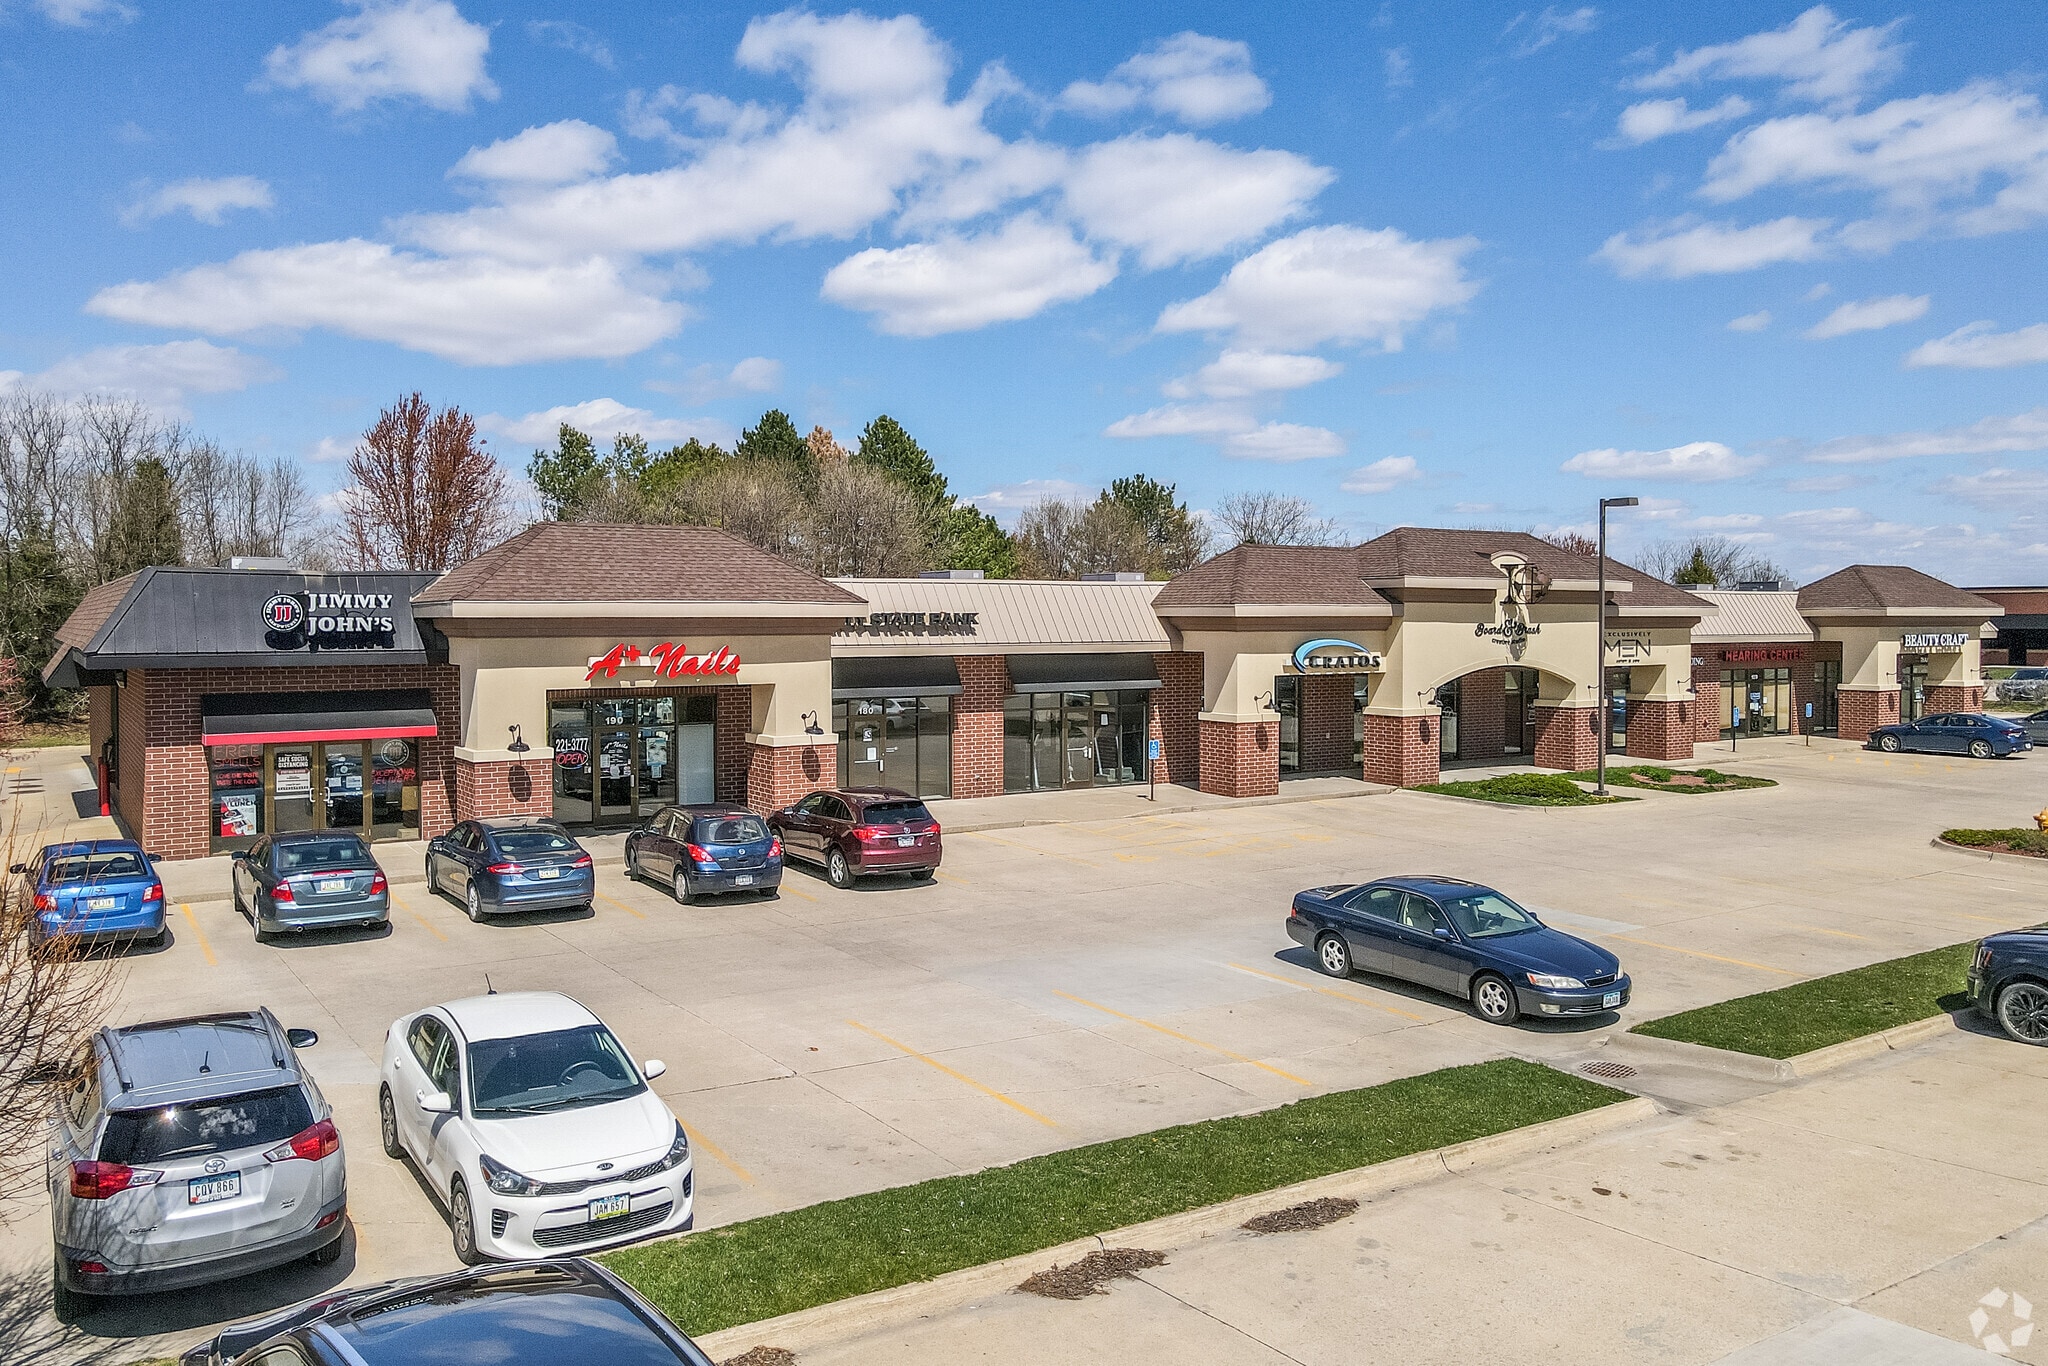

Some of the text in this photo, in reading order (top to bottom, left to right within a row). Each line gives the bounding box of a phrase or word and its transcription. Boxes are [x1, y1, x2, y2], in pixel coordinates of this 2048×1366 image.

[308, 593, 392, 612] JIMMY
[274, 604, 293, 622] JJ
[870, 612, 925, 626] STATE
[928, 612, 979, 625] BANK
[308, 617, 393, 636] JOHN'S
[1904, 633, 1969, 647] BEAUTY CRAFT
[1604, 639, 1651, 658] MEN
[1725, 650, 1768, 661] HEARING
[649, 642, 740, 679] Nails
[1308, 655, 1381, 669] CRATOS
[859, 707, 874, 715] 180
[605, 716, 624, 725] 190
[213, 744, 260, 758] FREE
[555, 737, 589, 752] 221-3777
[213, 757, 261, 768] SMELLS
[555, 752, 586, 765] OPEN
[195, 1179, 234, 1198] CQV 866
[594, 1200, 625, 1216] JAM 657
